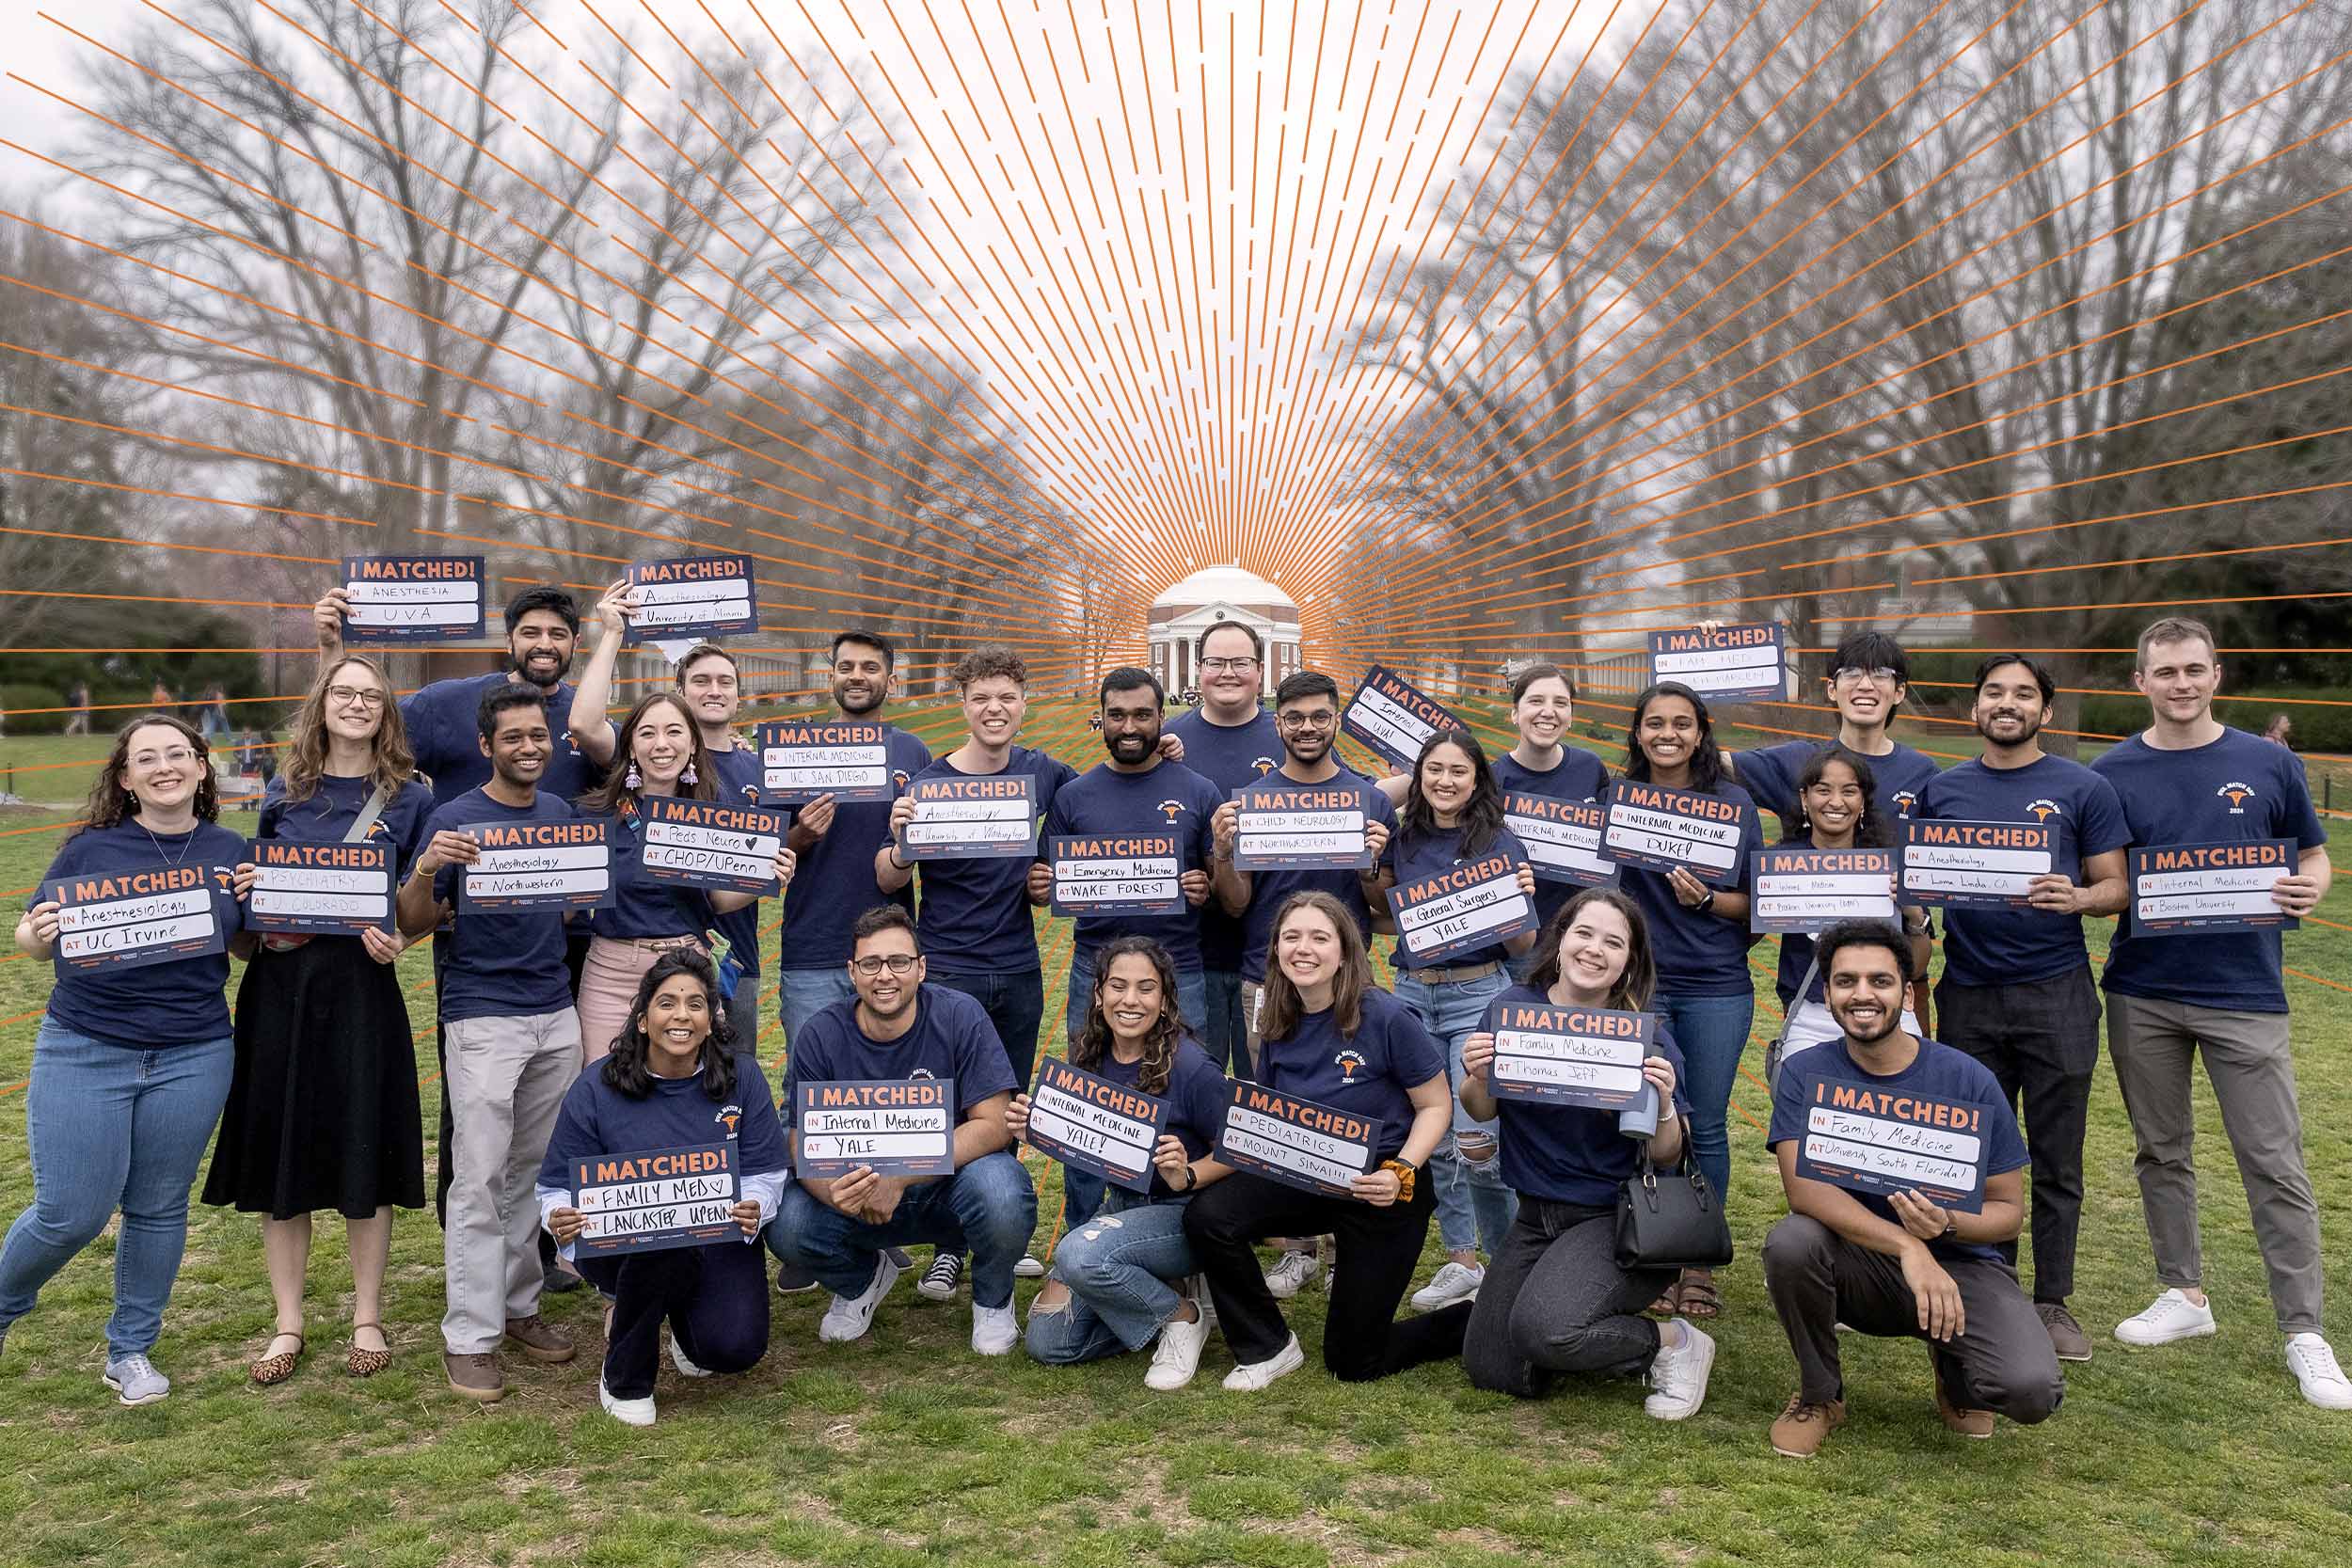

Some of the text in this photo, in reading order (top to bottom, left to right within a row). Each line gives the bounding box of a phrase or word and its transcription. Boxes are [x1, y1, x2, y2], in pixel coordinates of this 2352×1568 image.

[350, 561, 476, 579] I MATCHED!
[641, 559, 745, 581] MATCHED!
[373, 586, 452, 598] ANESTHESIA
[384, 607, 432, 622] UVA
[1657, 626, 1774, 651] I MATCHED!
[1372, 672, 1383, 687] I
[1351, 708, 1363, 718] AT
[1362, 691, 1416, 730] IN Internal
[767, 726, 883, 744] I MATCHED!
[784, 751, 828, 762] INTERNAL
[830, 752, 874, 762] MEDICINE
[811, 770, 833, 784] SAN
[837, 770, 867, 784] DIEGO
[921, 780, 1027, 799] MATCHED!
[1241, 790, 1360, 810] I MATCHED!
[1617, 784, 1741, 823] I MATCHED!
[652, 800, 781, 834] I MATCHED!
[1256, 816, 1286, 827] CHILD
[1294, 815, 1347, 829] NEUROLOGY
[1613, 810, 1726, 840] IN INTERNAL MEDICINE
[485, 824, 606, 847] MATCHED!
[649, 825, 741, 849] IN Peds Neuro
[909, 830, 920, 838] AT
[1242, 836, 1337, 850] AT NORTHWESTERN
[1514, 822, 1599, 846] INTERNAL MEDICINE
[1909, 824, 2048, 848] I MATCHED!
[255, 845, 385, 867] I MATCHED!
[1058, 837, 1175, 857] I MATCHED!
[1609, 832, 1692, 860] AT DUKE!
[489, 855, 559, 872] Anesthesiology
[646, 851, 660, 860] AT
[664, 848, 757, 874] CHOP/UPenn
[1073, 863, 1125, 878] Emergency
[1133, 861, 1175, 877] Medicine
[1760, 853, 1890, 873] I MATCHED!
[1908, 851, 1986, 868] IN Anesthesiology
[2140, 845, 2286, 871] I MATCHED!
[56, 886, 67, 904] I
[75, 865, 205, 902] MATCHED!
[271, 868, 361, 890] PSYCHIATRY
[469, 878, 563, 893] AT Northwestern
[1071, 884, 1108, 898] WAKE
[1118, 882, 1166, 895] FOREST
[1395, 892, 1405, 908] I
[1408, 853, 1513, 904] MATCHED!
[1931, 874, 1954, 886] Loma
[1994, 879, 2010, 889] CA
[2141, 876, 2259, 891] IN Internal Medicine
[62, 899, 186, 926] IN Anesthesiology
[254, 897, 360, 911] AT COLORADO
[1403, 889, 1498, 926] IN General Surgery
[2141, 897, 2236, 913] AT Boston University
[65, 925, 178, 951] AT UC Irvine
[1410, 917, 1470, 947] AT YALE
[1501, 1007, 1642, 1038] I MATCHED!
[1499, 1034, 1617, 1059] IN Family Medicine
[1497, 1060, 1598, 1081] AT Thomas Jeff
[808, 1085, 943, 1106] I MATCHED!
[1045, 1064, 1158, 1123] I MATCHED!
[1040, 1092, 1141, 1139] IN INTERNAL MEDICINE
[1234, 1085, 1372, 1143] I MATCHED!
[1816, 1083, 1980, 1132] I MATCHED!
[807, 1112, 941, 1130] IN Internal Medicine
[1032, 1117, 1107, 1154] AT YALE!
[1231, 1112, 1336, 1154] IN PEDIATRICS
[1813, 1116, 1954, 1153] IN Family Medicine
[807, 1136, 877, 1156] AT YALE
[1226, 1134, 1240, 1145] AT
[1243, 1137, 1288, 1160] MOUNT
[580, 1148, 728, 1183] I MATCHED!
[1809, 1144, 1823, 1153] AT
[1877, 1153, 1908, 1168] South
[1914, 1161, 1967, 1179] Florida!
[582, 1178, 707, 1209] IN FAMILY MED
[585, 1203, 733, 1234] AT LANCASTER UPENN
